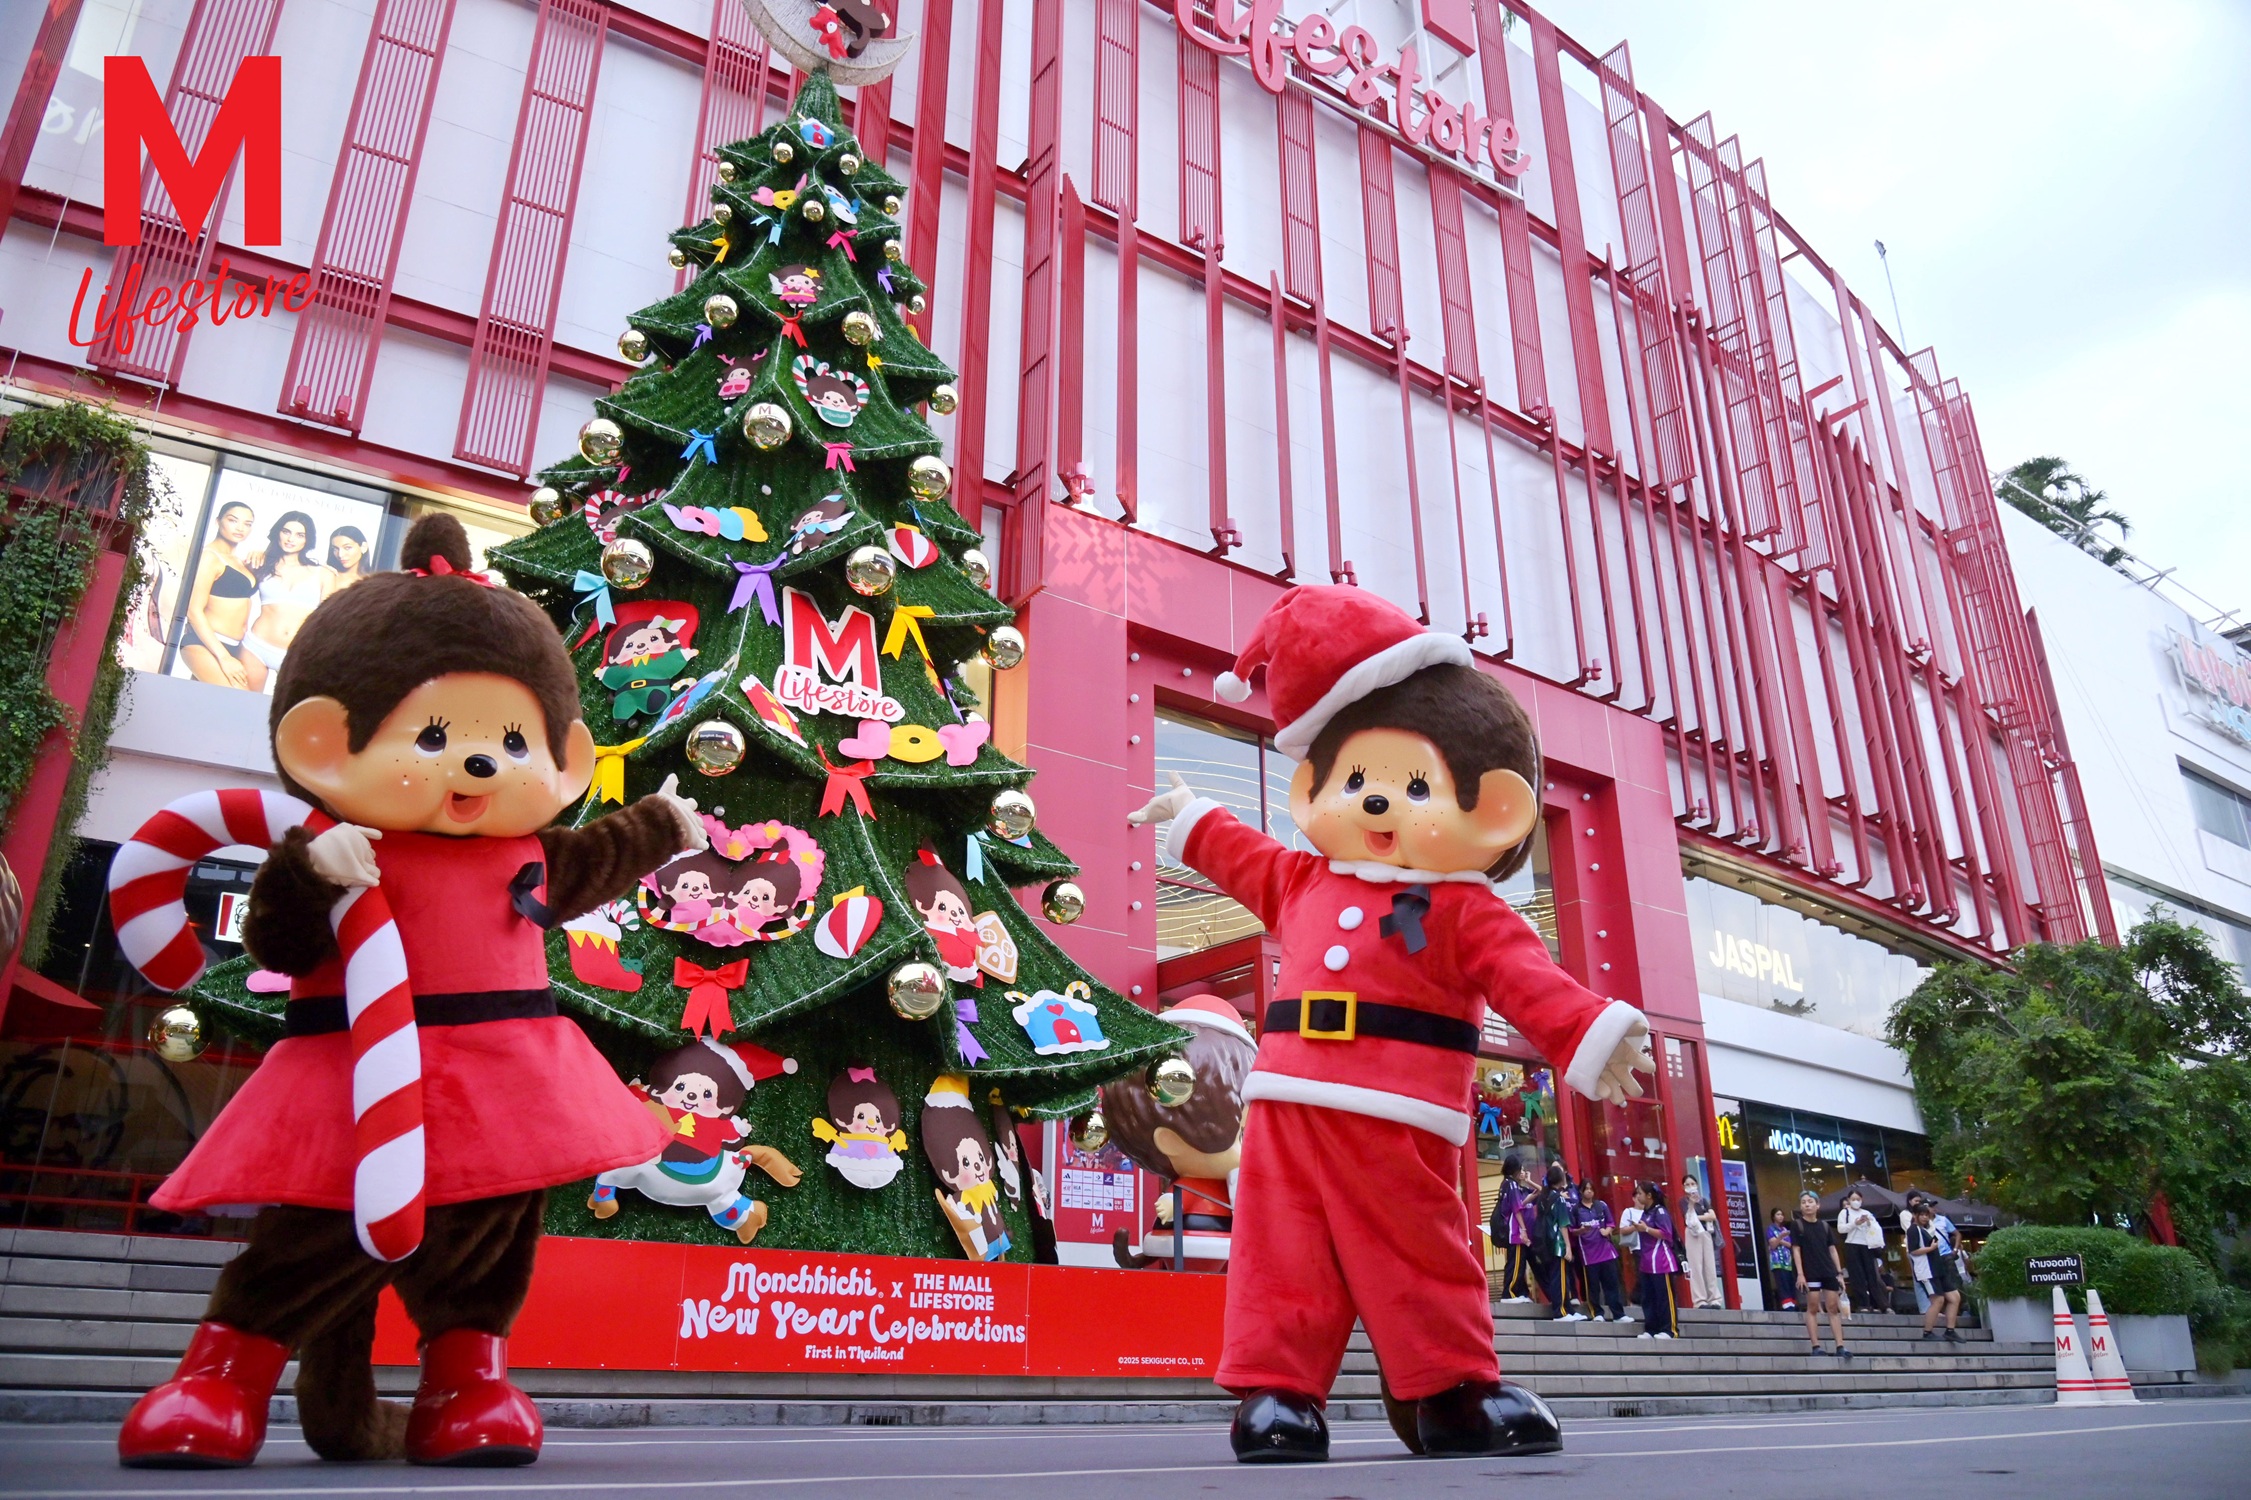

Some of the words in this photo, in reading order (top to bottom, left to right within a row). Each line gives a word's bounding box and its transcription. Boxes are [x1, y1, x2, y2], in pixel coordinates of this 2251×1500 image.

[790, 592, 878, 691] M
[780, 670, 898, 717] Lifestore
[838, 719, 991, 767] JOY
[1709, 929, 1804, 993] JASPAL
[1768, 1128, 1856, 1164] McDonald's
[1092, 1212, 1104, 1228] M
[2029, 1257, 2077, 1268] ห้ามจอดทับ
[913, 1273, 945, 1290] THE
[949, 1275, 992, 1292] MALL
[2031, 1270, 2078, 1282] ทางเดินเท้า
[909, 1292, 994, 1311] LIFESTORE
[680, 1298, 760, 1339] New
[770, 1301, 865, 1340] Year
[869, 1304, 1026, 1344] Celebrations
[2056, 1336, 2071, 1351] M
[2091, 1336, 2106, 1351] M
[804, 1344, 832, 1359] First
[834, 1345, 847, 1359] in
[847, 1346, 905, 1363] Thailand
[1118, 1356, 1140, 1364] ©2025
[1141, 1357, 1176, 1365] SEKIGUCHI
[1177, 1357, 1191, 1366] CO.,
[1191, 1357, 1205, 1365] LTD.
